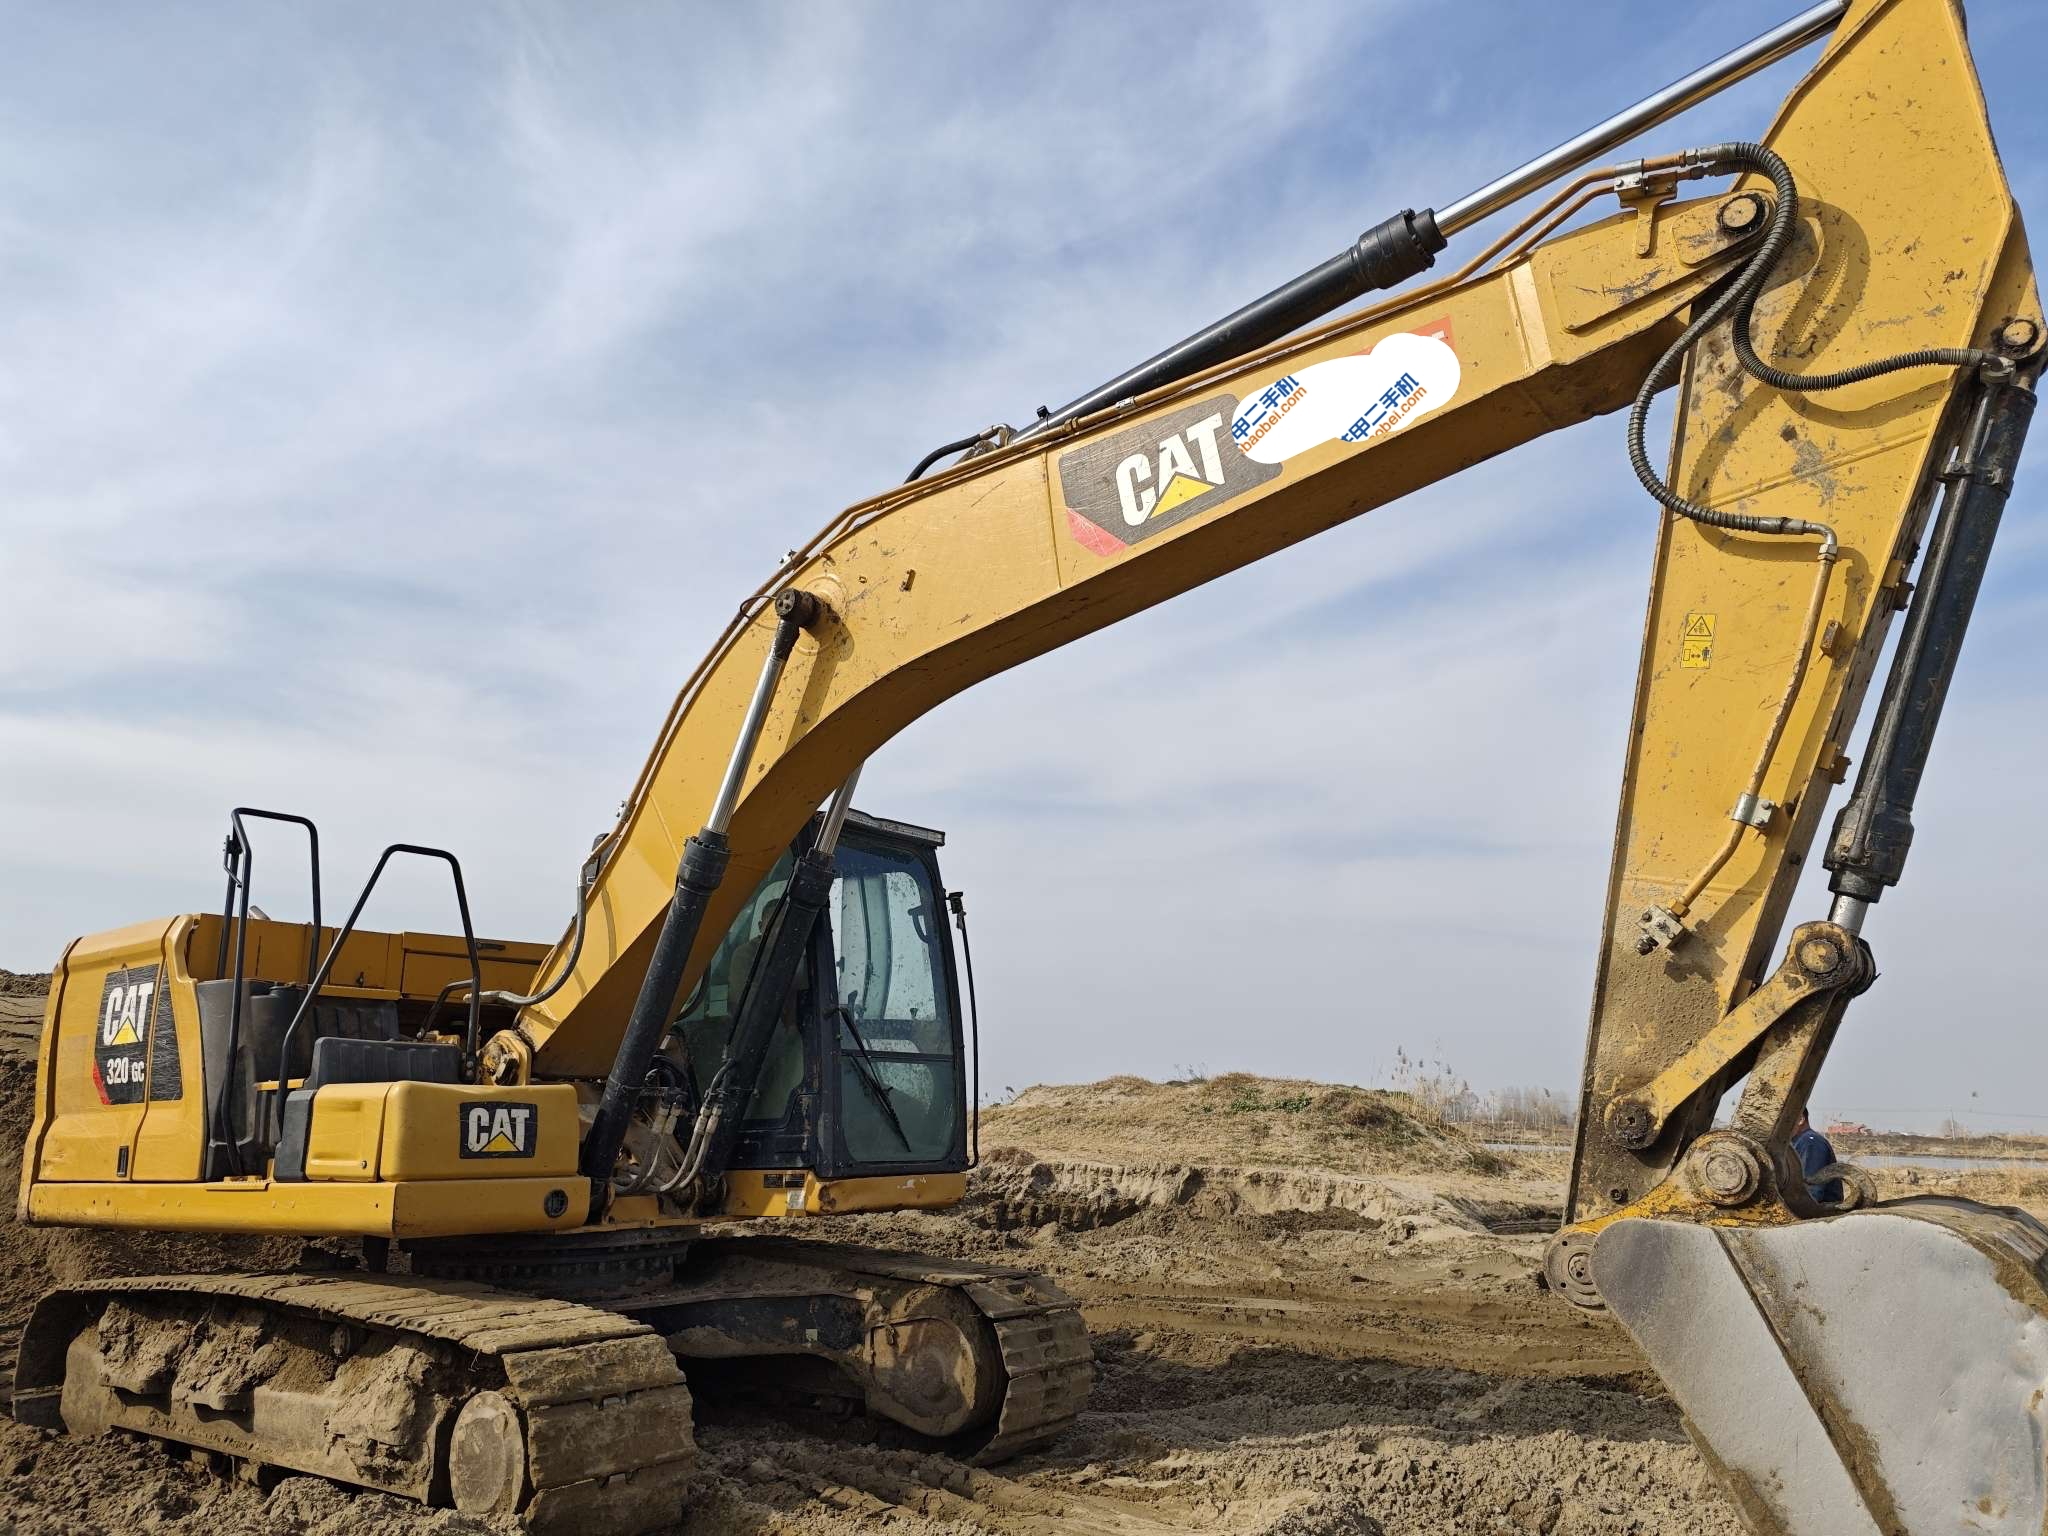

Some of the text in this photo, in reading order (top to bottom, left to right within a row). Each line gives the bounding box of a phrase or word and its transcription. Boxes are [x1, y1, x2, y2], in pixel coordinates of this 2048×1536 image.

[1115, 413, 1226, 527] CAT
[103, 982, 154, 1046] CAT
[106, 1056, 145, 1085] 320 GC
[467, 1107, 530, 1152] CAT
